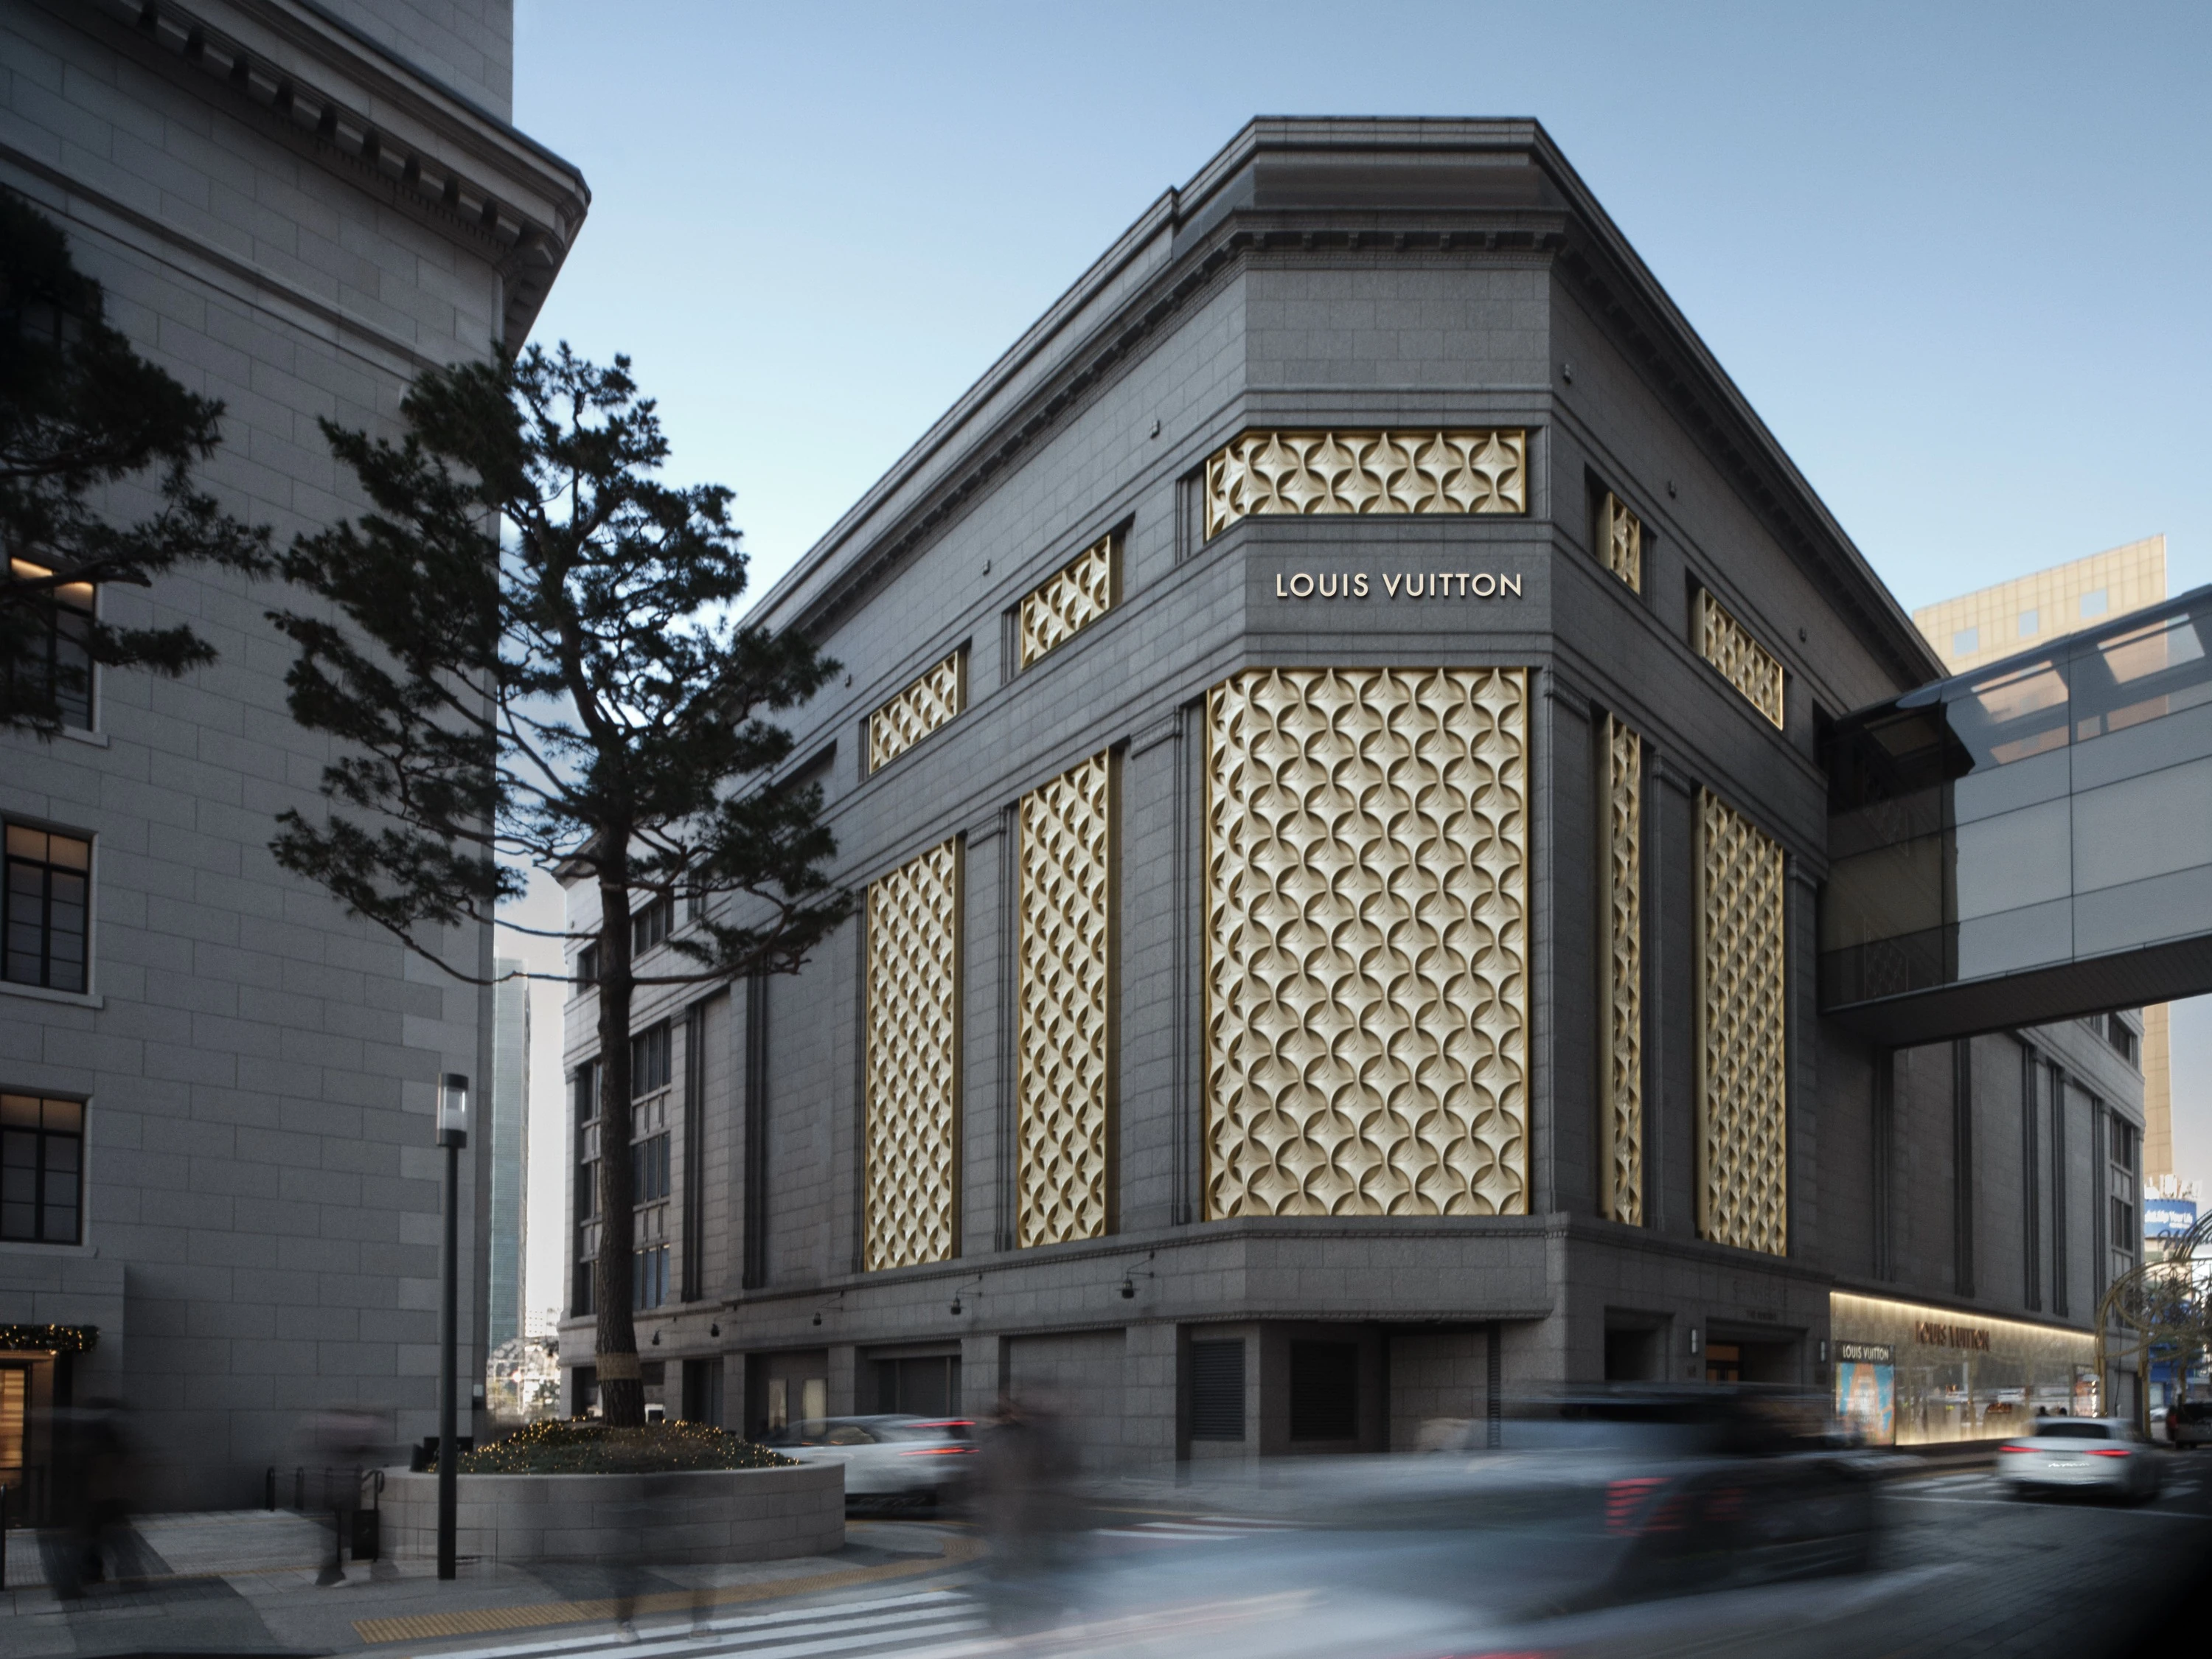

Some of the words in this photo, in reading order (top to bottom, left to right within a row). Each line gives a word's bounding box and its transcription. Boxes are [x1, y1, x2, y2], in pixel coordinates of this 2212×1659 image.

[1276, 573, 1369, 597] LOUIS
[1382, 573, 1522, 598] VUITTON
[1843, 1345, 1862, 1360] LOUIS
[1863, 1346, 1889, 1360] VUITTON
